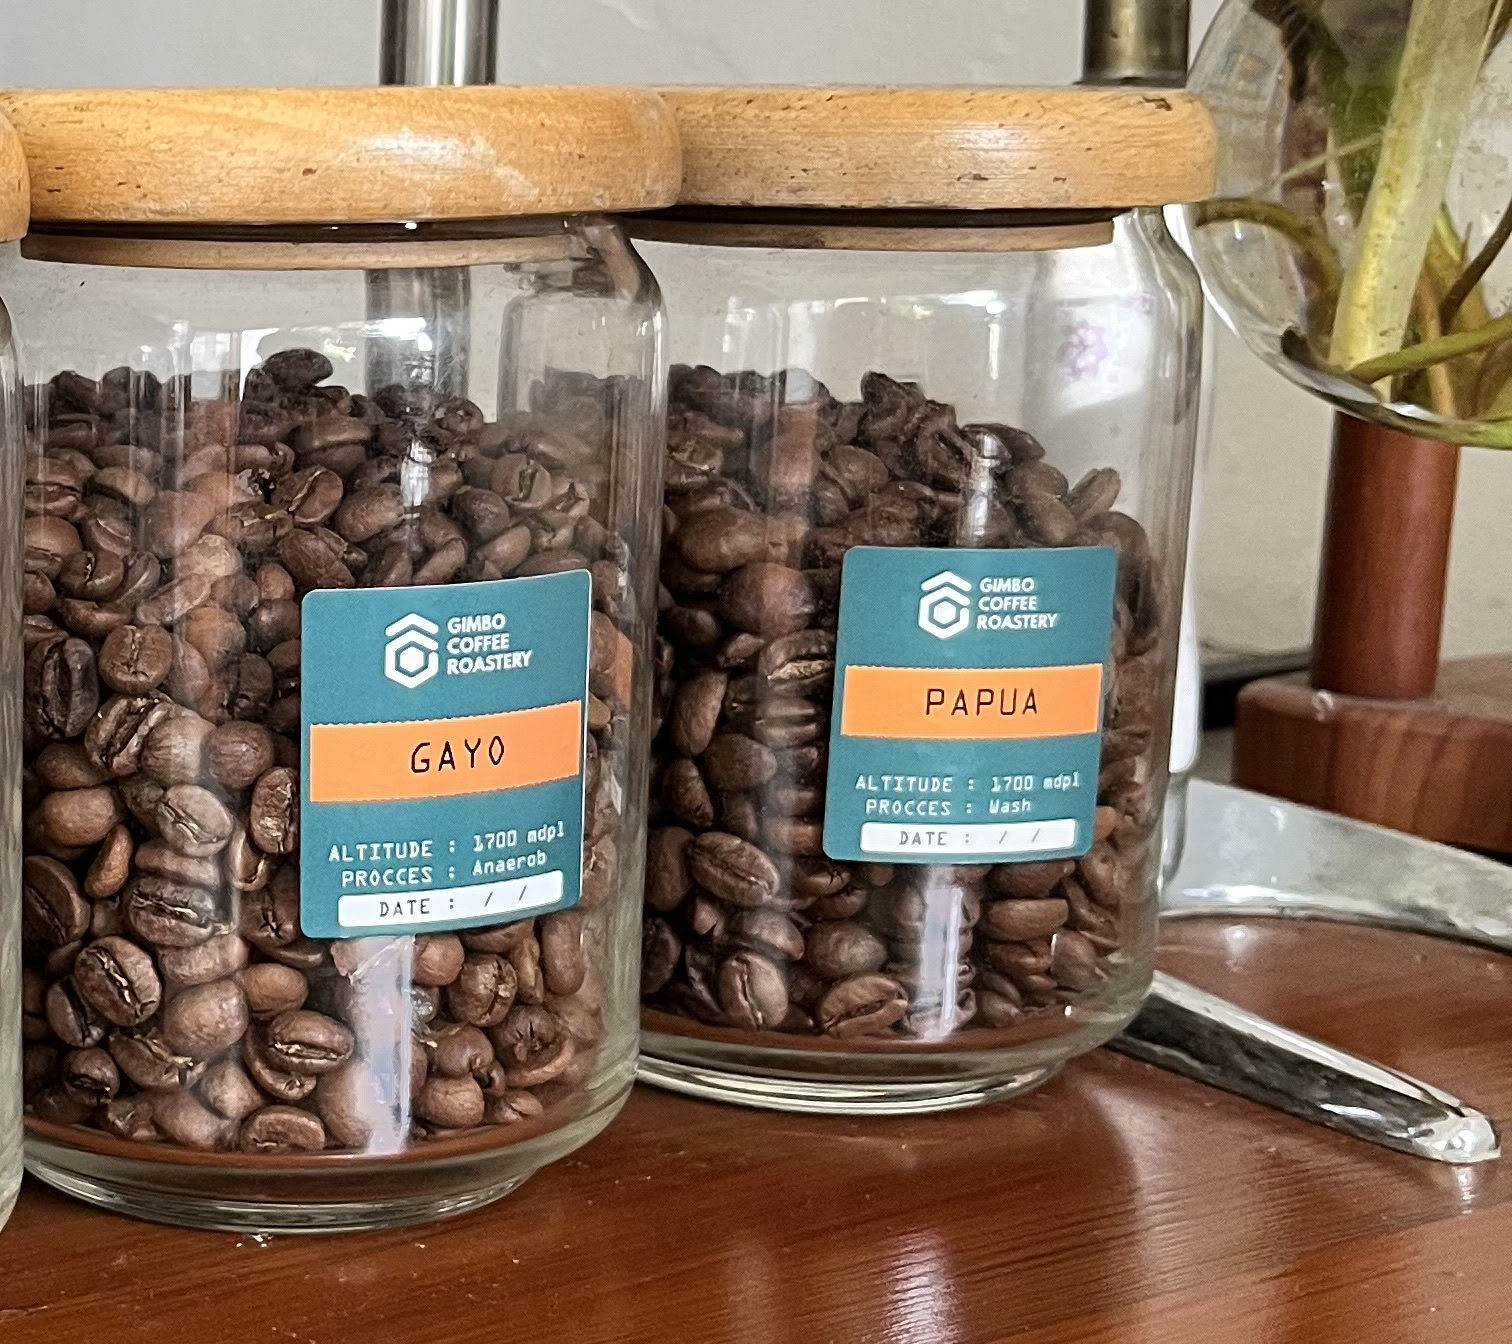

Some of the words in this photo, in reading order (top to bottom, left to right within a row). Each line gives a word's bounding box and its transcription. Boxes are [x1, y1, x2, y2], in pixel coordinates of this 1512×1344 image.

[979, 577, 1035, 593] GIMBO
[978, 596, 1037, 611] COFFEE
[447, 613, 506, 634] GIMBO
[977, 613, 1058, 629] ROASTERY
[447, 633, 509, 654] COFFEE
[447, 651, 533, 674] ROASTERY
[925, 688, 1038, 716] PAPUA
[411, 736, 505, 773] GAYO
[855, 774, 953, 792] ALTITUDE
[991, 775, 1034, 792] 1700
[1043, 772, 1080, 791] mdpl
[865, 799, 951, 816] PROCCES
[989, 798, 1031, 813] Wash
[329, 840, 433, 862] ALTITUDE
[473, 830, 517, 852] 1700
[528, 821, 564, 844] mdpl
[899, 831, 947, 845] DATE
[342, 866, 433, 888] PROCCES
[472, 851, 546, 876] Anaerob
[380, 899, 430, 917] DATE
